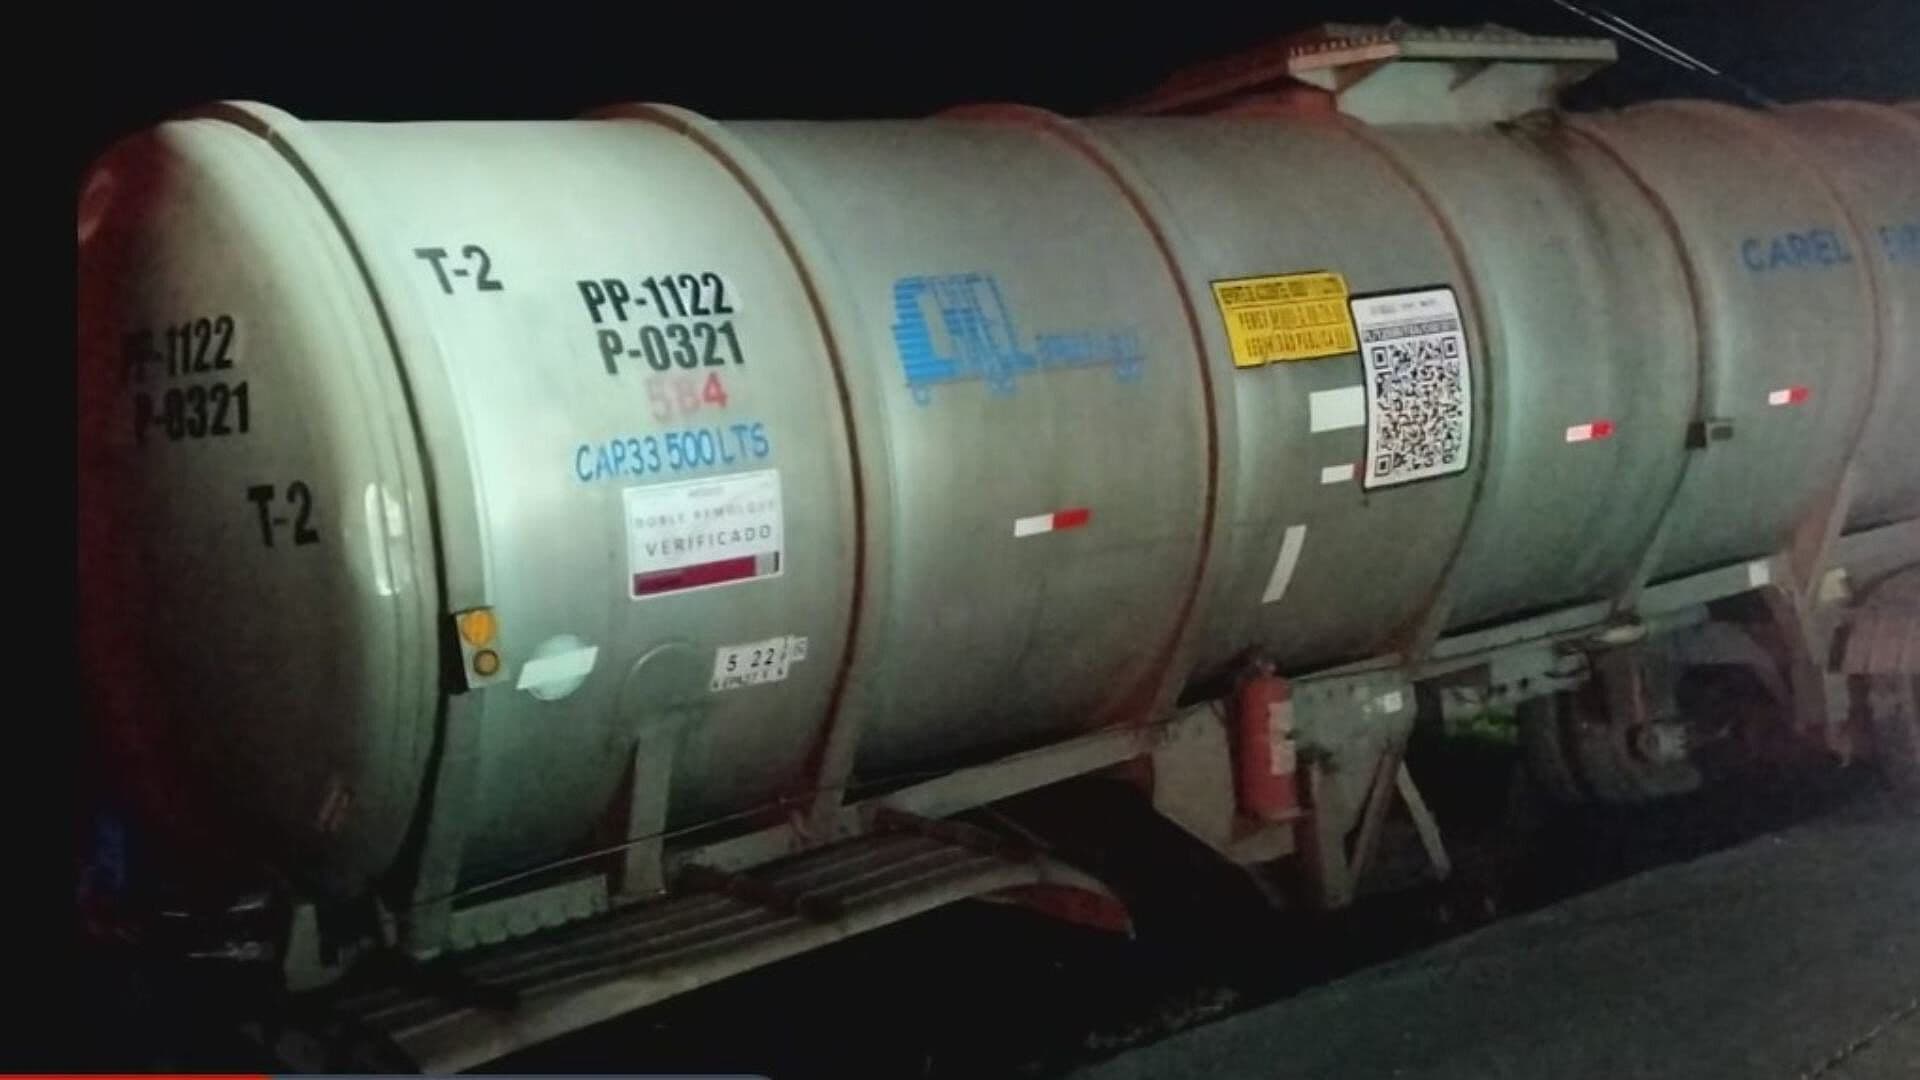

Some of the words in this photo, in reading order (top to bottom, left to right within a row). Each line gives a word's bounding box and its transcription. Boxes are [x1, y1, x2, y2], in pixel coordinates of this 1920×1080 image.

[414, 245, 505, 295] T-2
[577, 272, 734, 324] PP-1122
[597, 320, 746, 375] P-0321
[134, 381, 250, 445] P-0321
[247, 480, 320, 547] T-2
[645, 524, 772, 557] VERIFICADO
[726, 653, 738, 672] 5
[751, 647, 776, 668] 22
